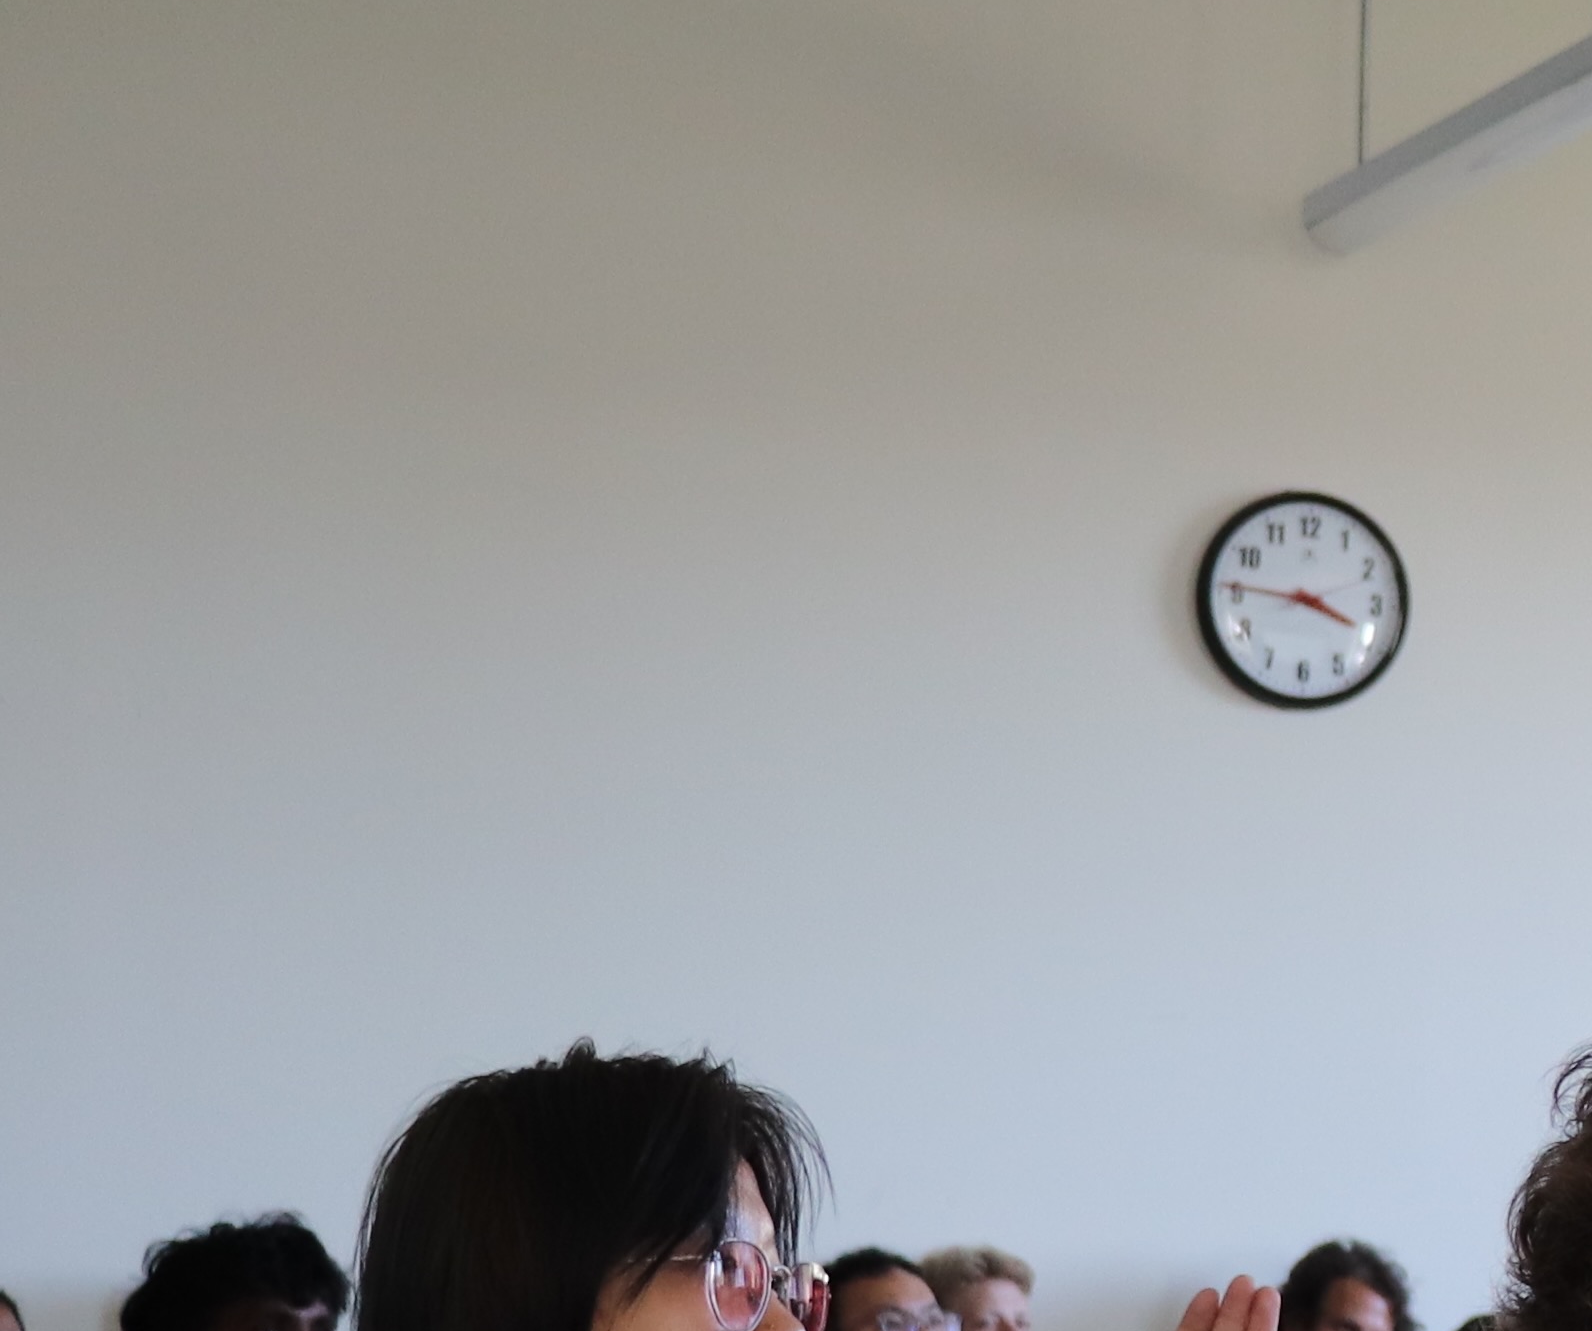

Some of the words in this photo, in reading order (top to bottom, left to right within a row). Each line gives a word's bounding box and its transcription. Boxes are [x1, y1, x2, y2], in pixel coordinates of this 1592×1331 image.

[1266, 522, 1286, 544] 11
[1301, 516, 1322, 538] 12
[1340, 529, 1350, 552] 1
[1239, 547, 1261, 570] 10
[1362, 558, 1375, 581] 2
[1370, 594, 1383, 617] 3
[1264, 647, 1275, 670] 7
[1333, 653, 1345, 676] 5
[1297, 660, 1310, 683] 6
